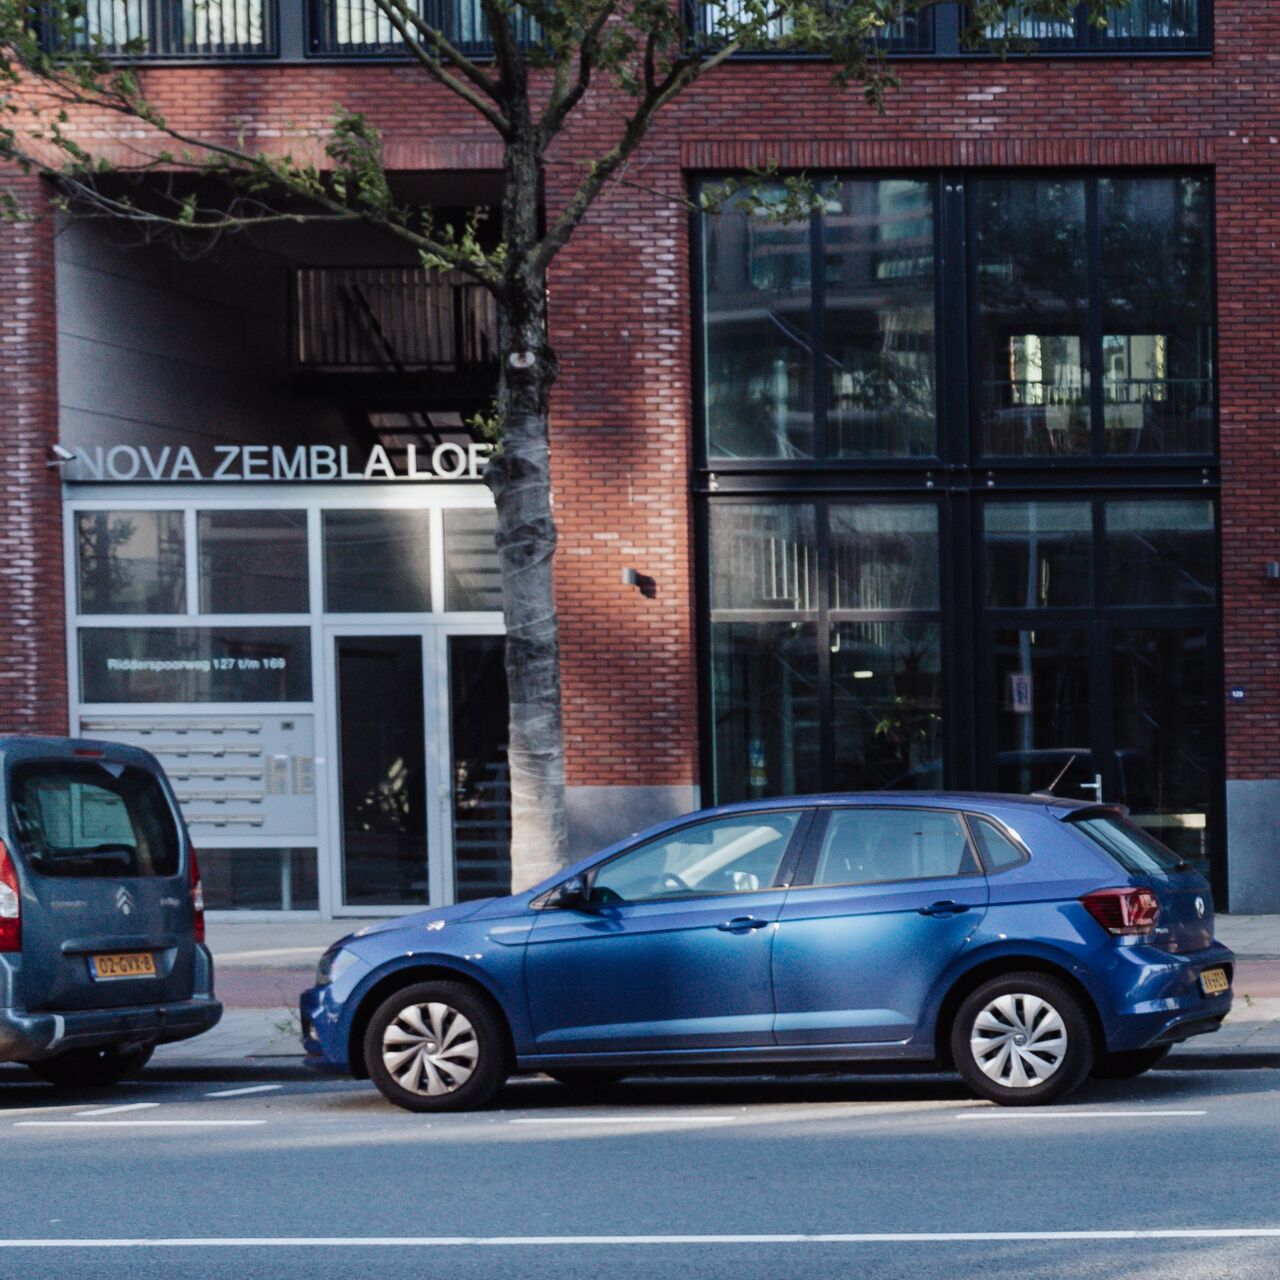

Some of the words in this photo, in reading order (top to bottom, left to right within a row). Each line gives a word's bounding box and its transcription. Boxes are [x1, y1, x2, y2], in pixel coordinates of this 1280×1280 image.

[76, 445, 202, 480] NOVA
[213, 444, 397, 480] ZEMBLA
[407, 442, 493, 479] LOF
